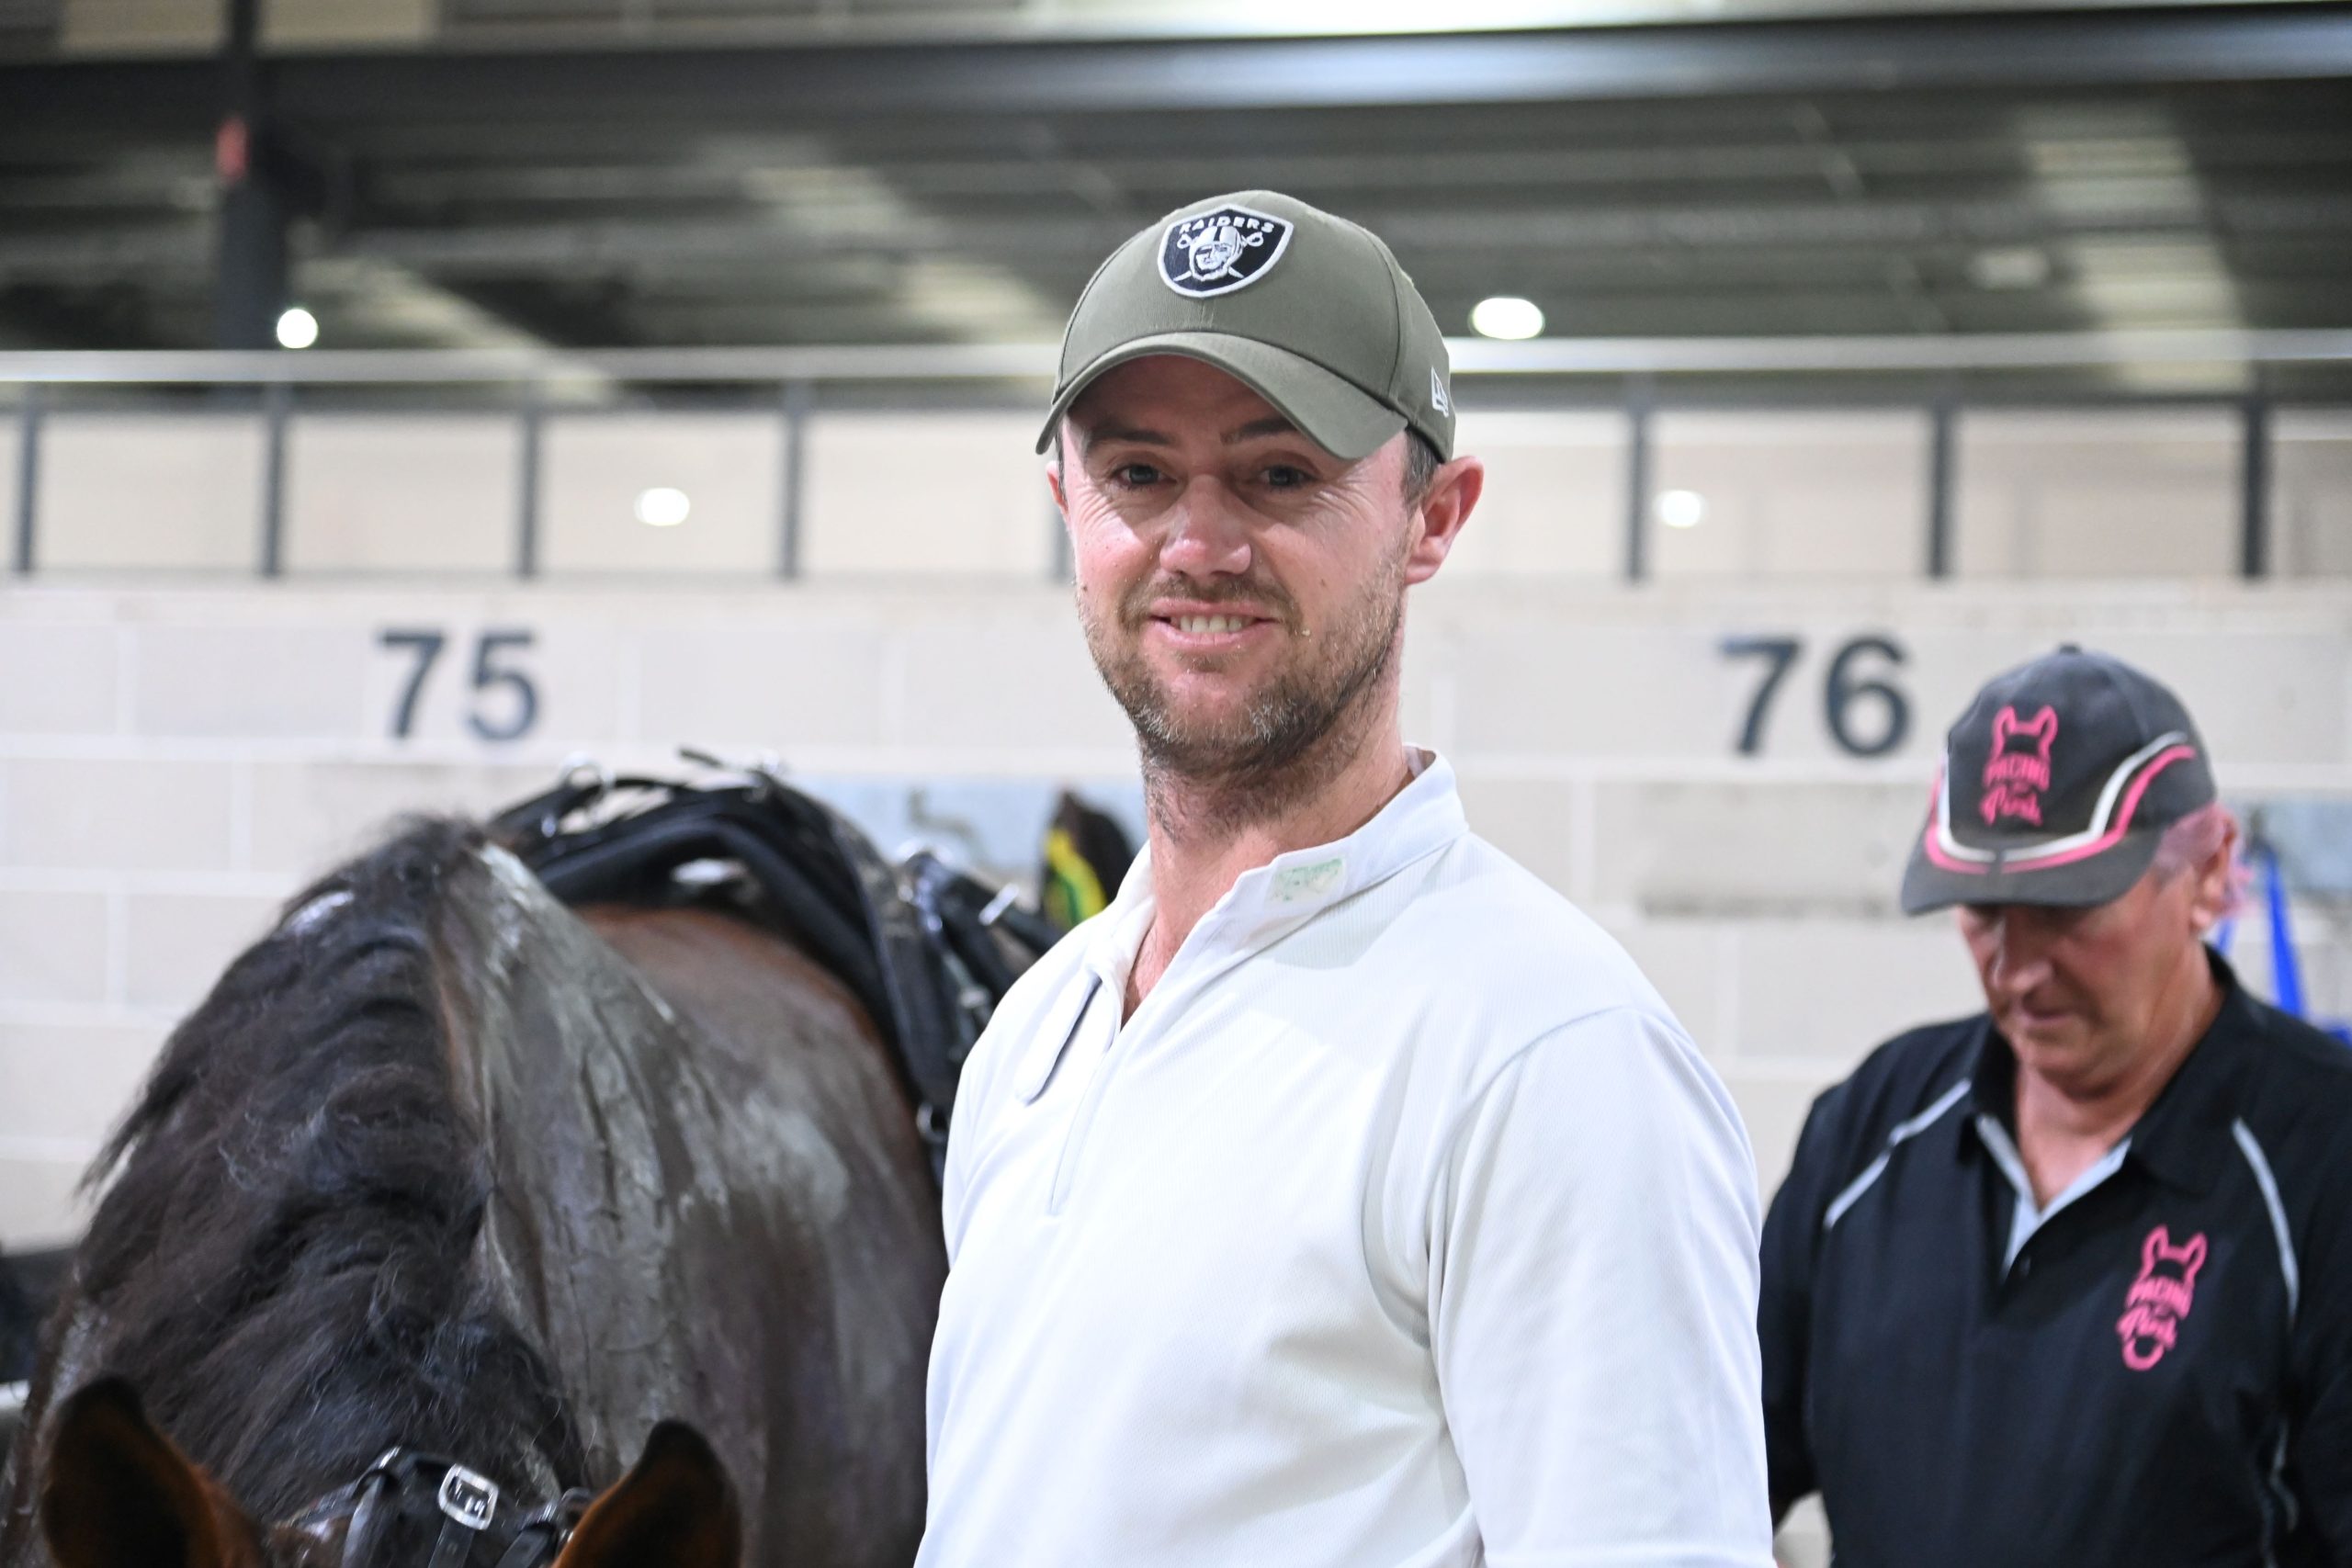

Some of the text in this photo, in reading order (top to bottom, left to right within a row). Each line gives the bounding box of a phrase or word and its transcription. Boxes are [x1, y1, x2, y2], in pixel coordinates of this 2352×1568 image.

[1179, 215, 1275, 234] RAIDERS
[376, 628, 540, 742] 75
[1719, 634, 1913, 758] 76
